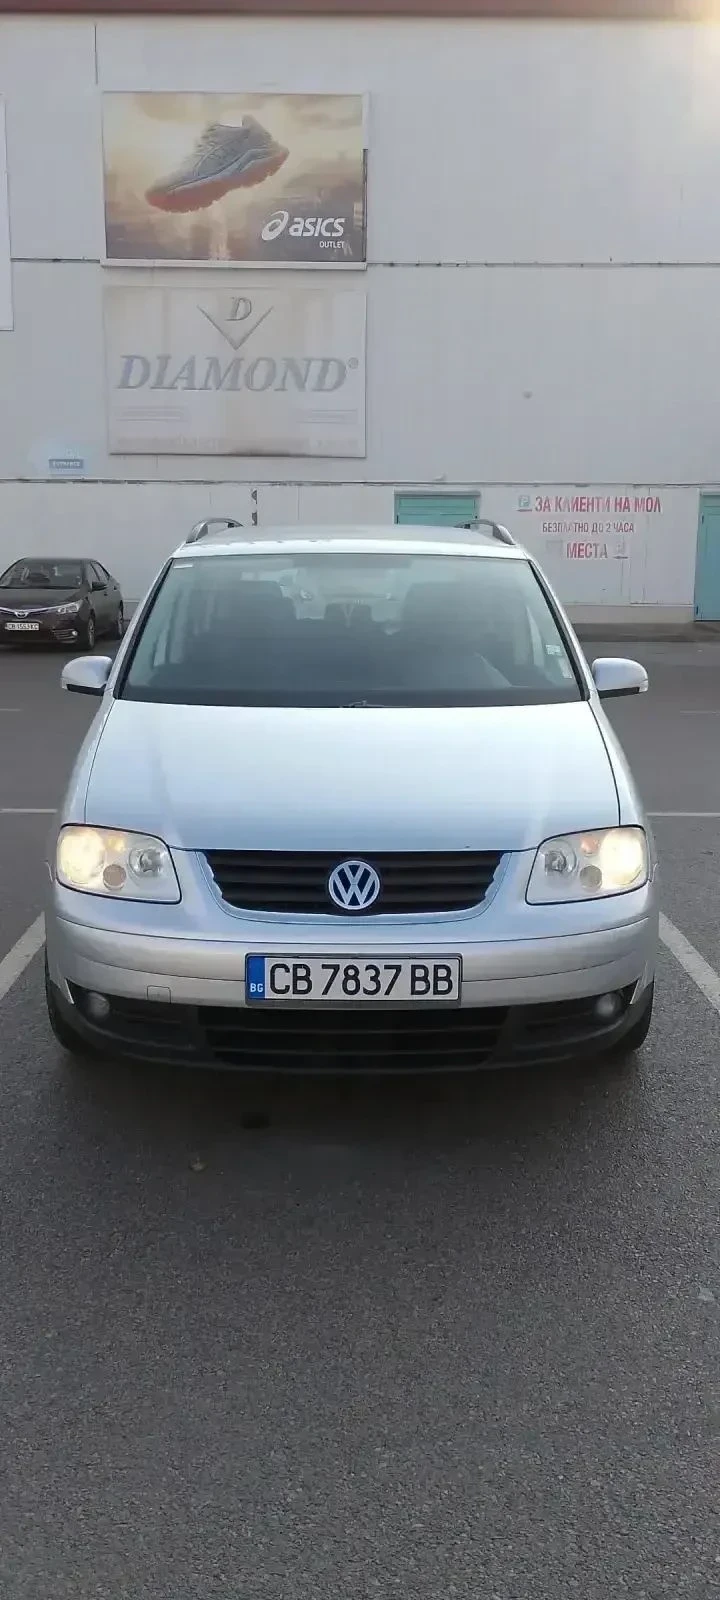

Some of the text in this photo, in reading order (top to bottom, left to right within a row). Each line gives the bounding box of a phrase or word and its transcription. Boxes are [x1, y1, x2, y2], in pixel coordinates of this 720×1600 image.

[289, 217, 345, 237] asics
[320, 241, 344, 249] OUTLET
[225, 297, 252, 322] D
[535, 496, 661, 513] ЗА КЛИЕНТИ НА МОЛ
[591, 522, 604, 534] ДО
[606, 522, 611, 533] 2
[613, 522, 634, 533] ЧАСА
[566, 543, 608, 559] МЕСТА
[329, 860, 380, 911] VW
[250, 983, 264, 993] BG
[270, 963, 453, 996] CB 7837 BB
